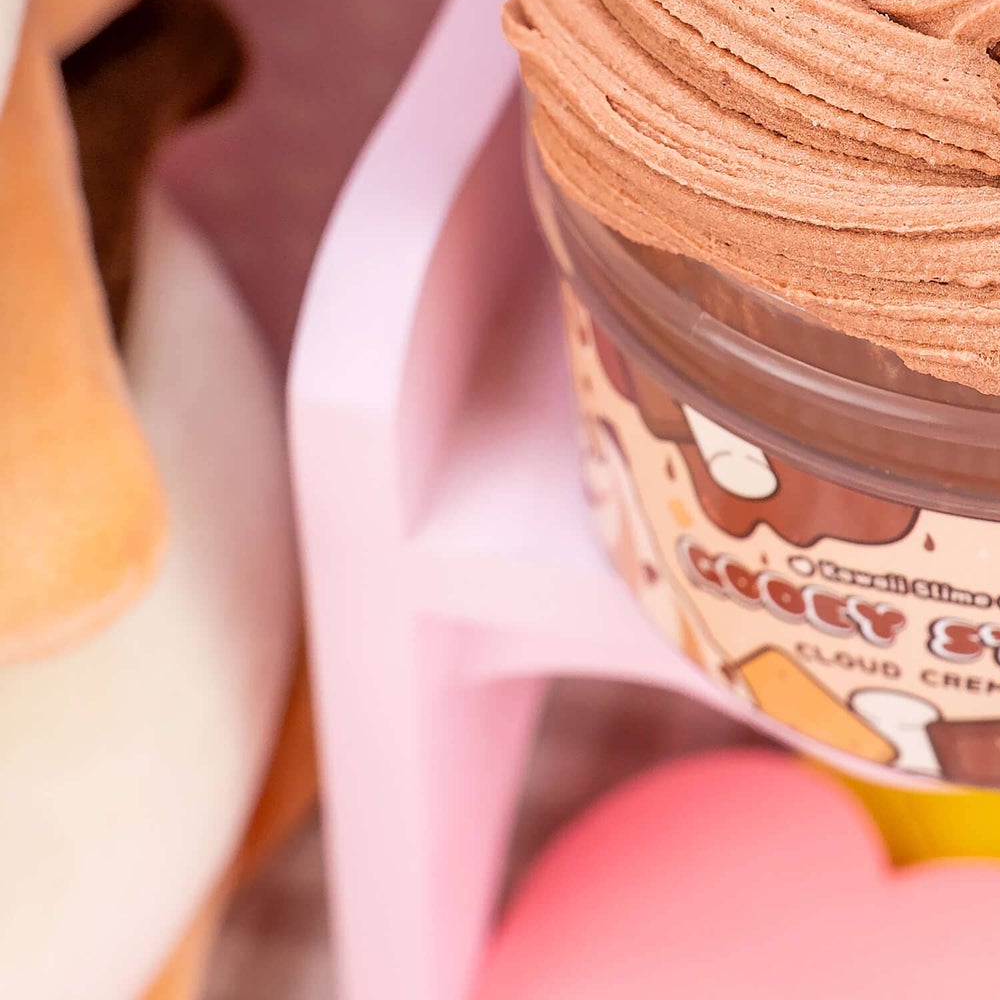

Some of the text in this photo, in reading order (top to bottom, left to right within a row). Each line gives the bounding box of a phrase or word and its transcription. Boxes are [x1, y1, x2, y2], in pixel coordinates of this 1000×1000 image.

[818, 560, 908, 595] Kawaii
[912, 579, 992, 609] Slime
[795, 642, 901, 679] CLOUD
